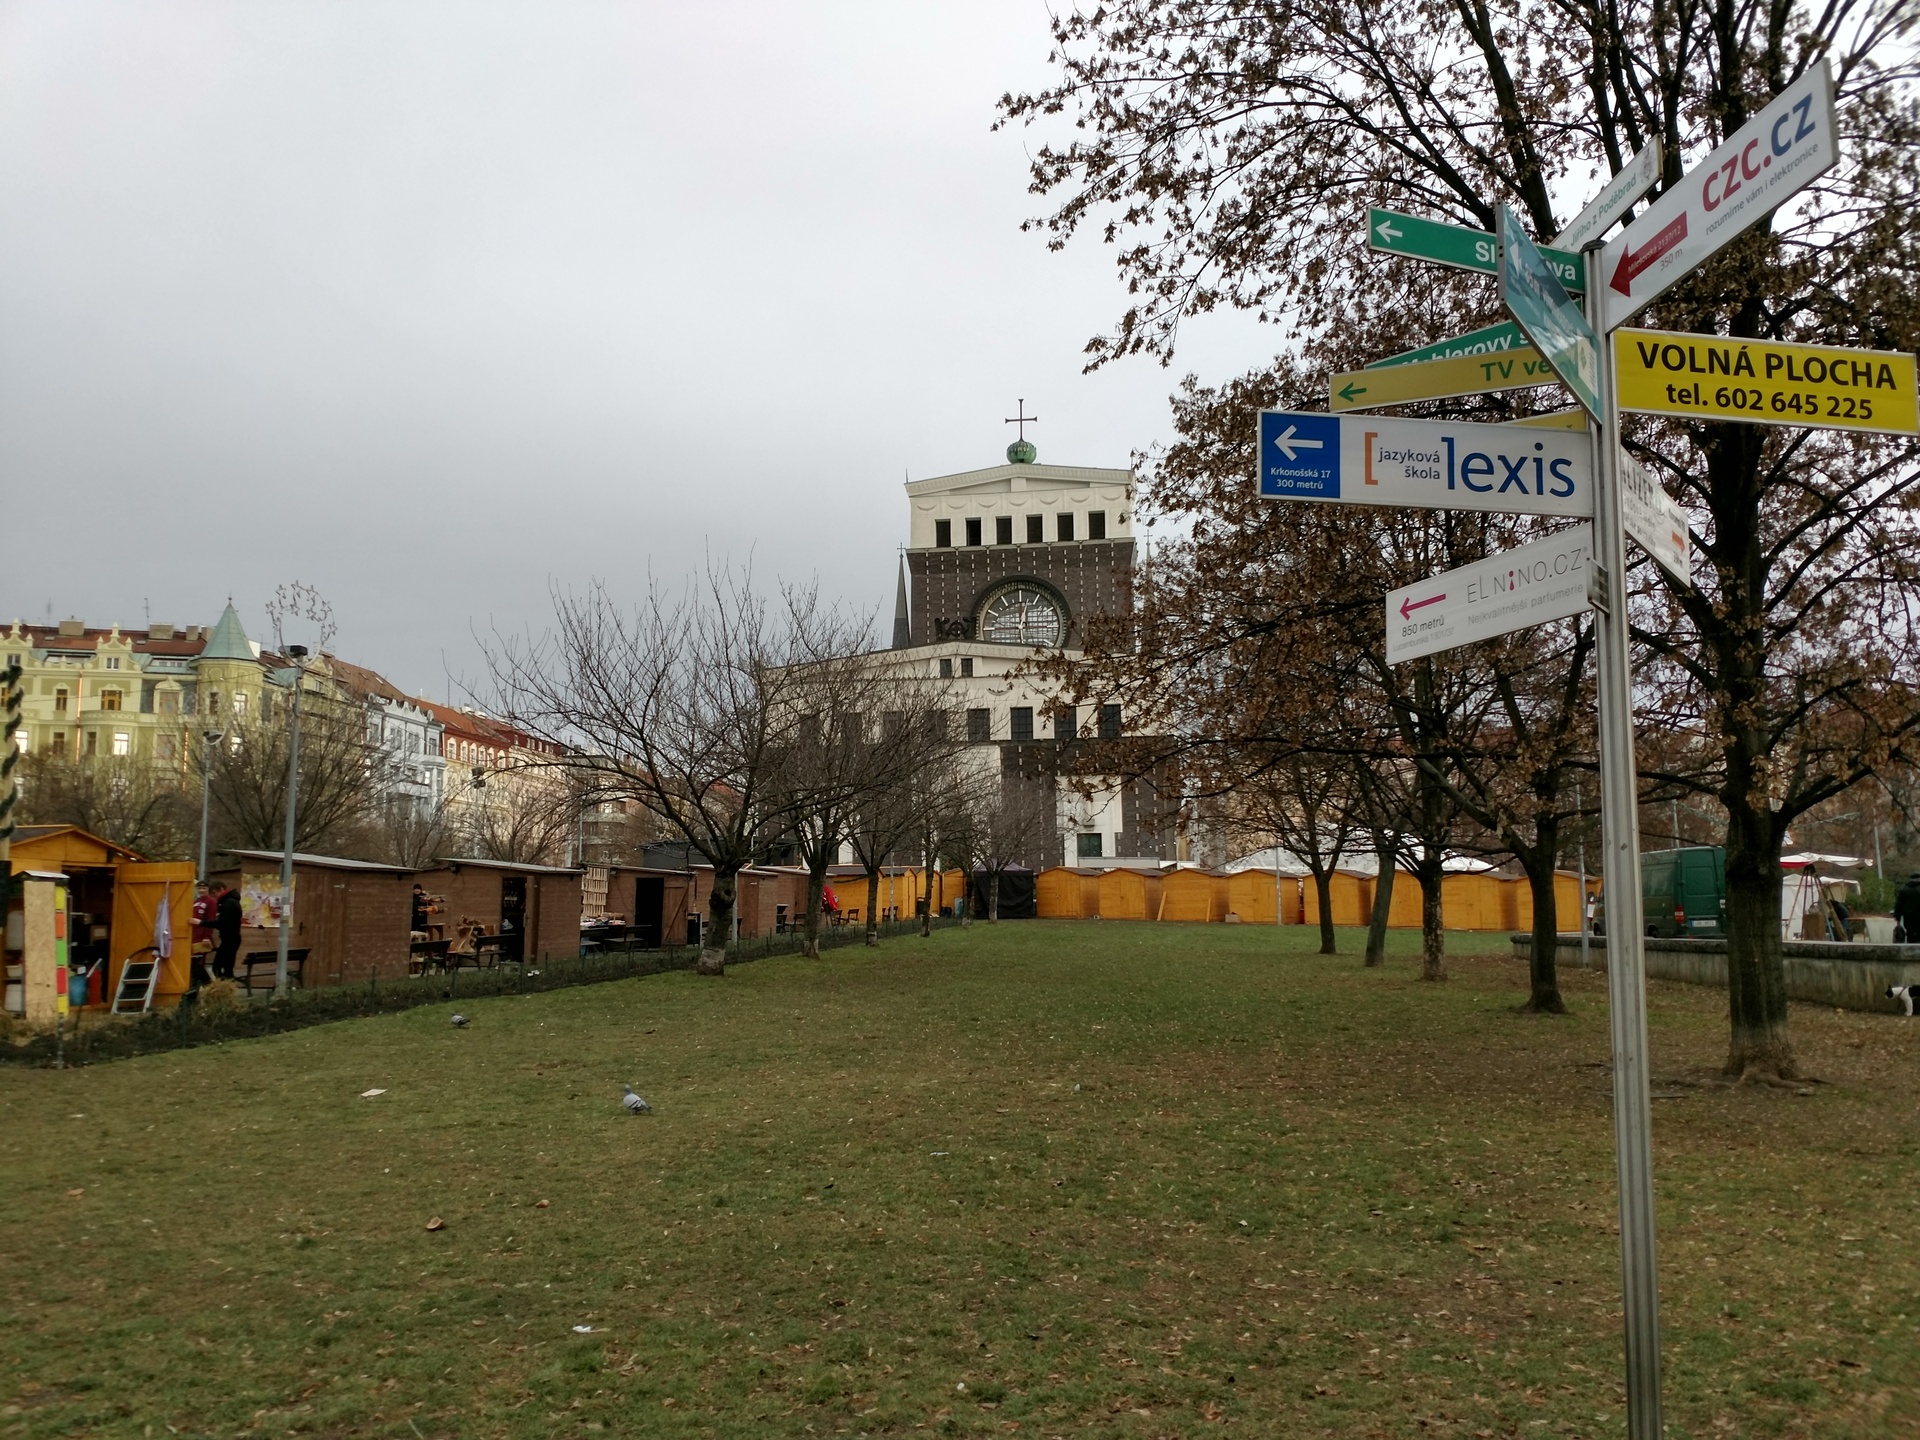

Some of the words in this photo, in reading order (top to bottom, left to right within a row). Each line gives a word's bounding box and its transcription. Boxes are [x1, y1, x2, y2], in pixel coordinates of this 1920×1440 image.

[1703, 92, 1816, 212] CZC.CZ
[1592, 214, 1598, 226] z
[1599, 173, 1637, 219] Poděbrad
[1706, 199, 1745, 236] rozumíme
[1746, 185, 1764, 203] vám
[1770, 143, 1819, 187] elektronice
[1660, 253, 1674, 271] 350
[1674, 248, 1683, 260] m
[1480, 359, 1514, 381] TV
[1637, 341, 1756, 378] VOLNÁ
[1765, 353, 1897, 390] PLOCHA
[1666, 383, 1708, 406] tel.
[1715, 387, 1764, 411] 602
[1770, 391, 1819, 415] 645
[1826, 396, 1873, 420] 225
[1270, 467, 1319, 478] Krkonošská
[1320, 470, 1331, 478] 17
[1276, 478, 1294, 488] 300
[1378, 447, 1440, 464] jazyková
[1441, 436, 1575, 498] lexis
[1404, 465, 1440, 480] škola
[1467, 601, 1527, 625] Nejkvalitnější
[1531, 584, 1584, 608] parfumerie
[1402, 623, 1417, 637] 850
[1420, 614, 1445, 632] metrů
